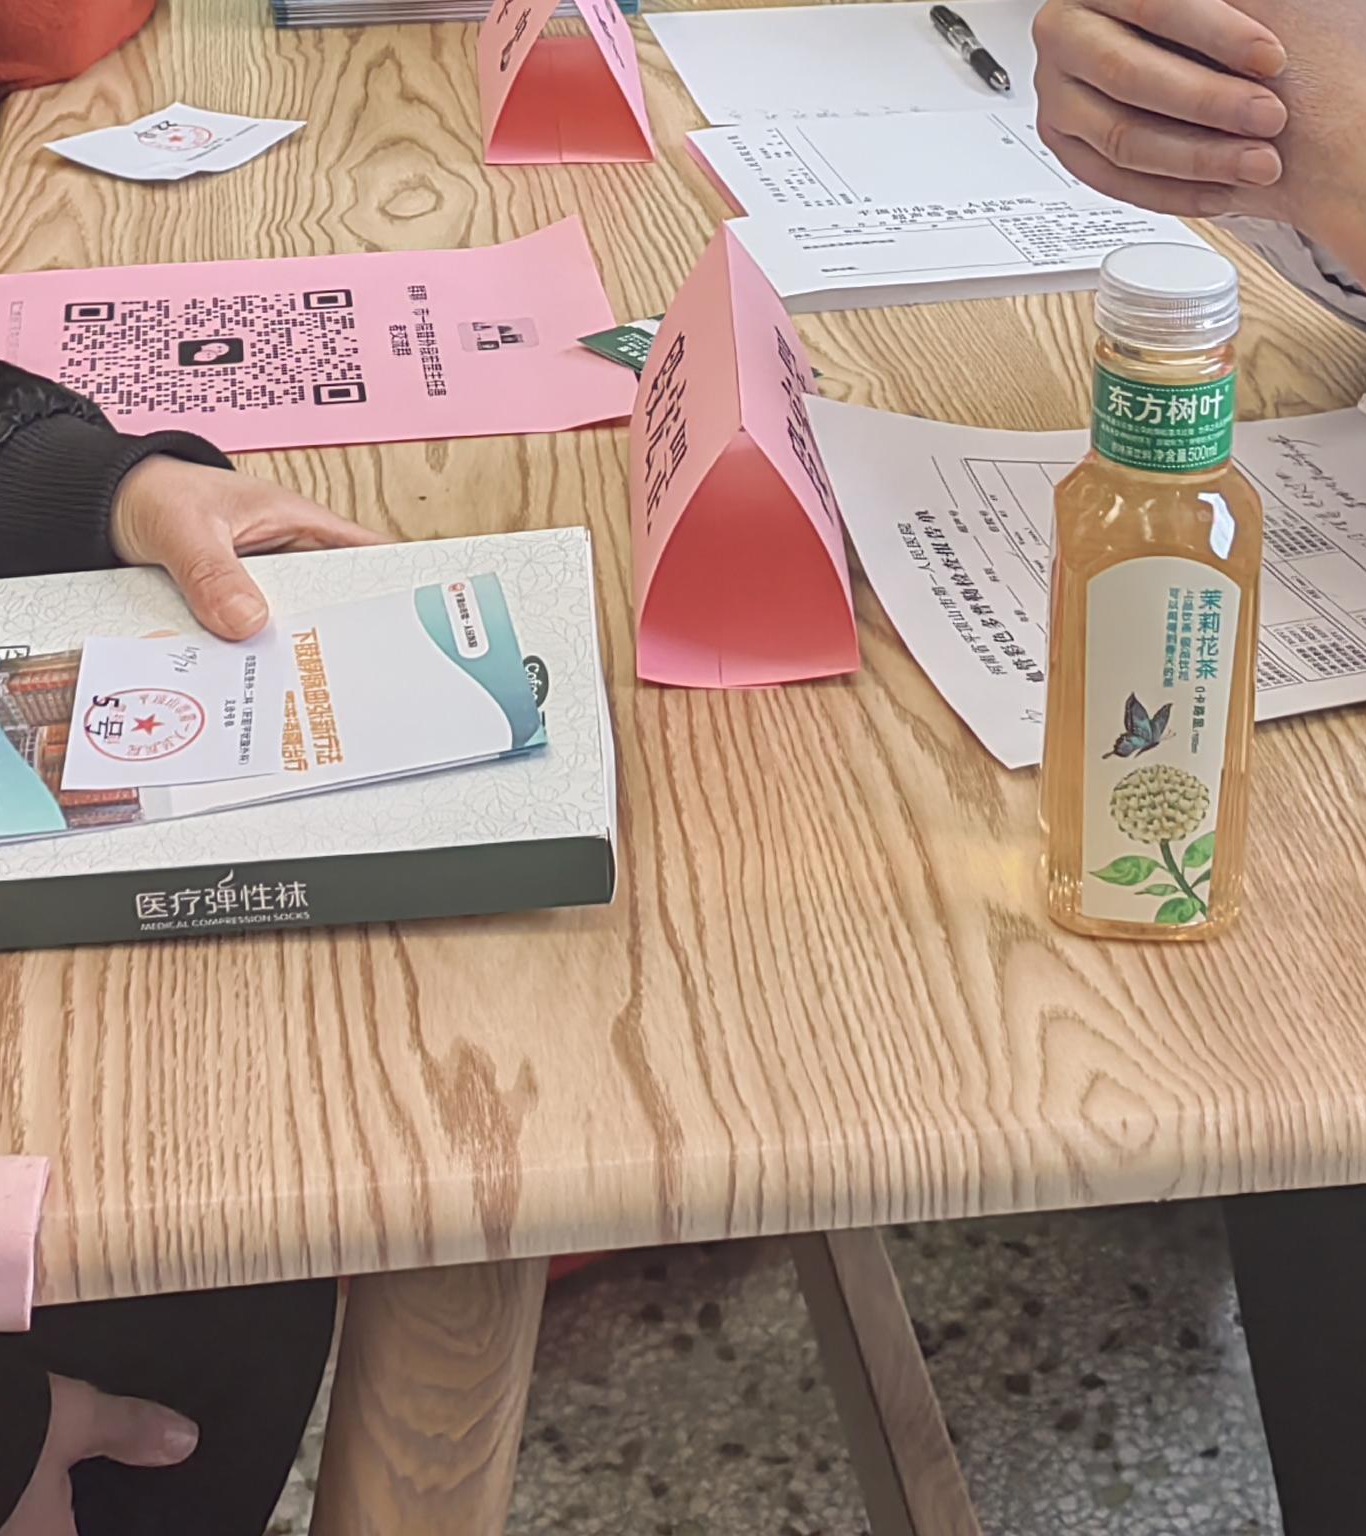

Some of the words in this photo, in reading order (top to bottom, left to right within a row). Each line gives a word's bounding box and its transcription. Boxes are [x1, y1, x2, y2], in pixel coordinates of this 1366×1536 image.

[1107, 385, 1224, 426] 东方树叶
[1195, 588, 1222, 680] 茉莉花茶
[135, 868, 310, 920] 医疗弹性袜
[273, 911, 311, 923] SOCKS
